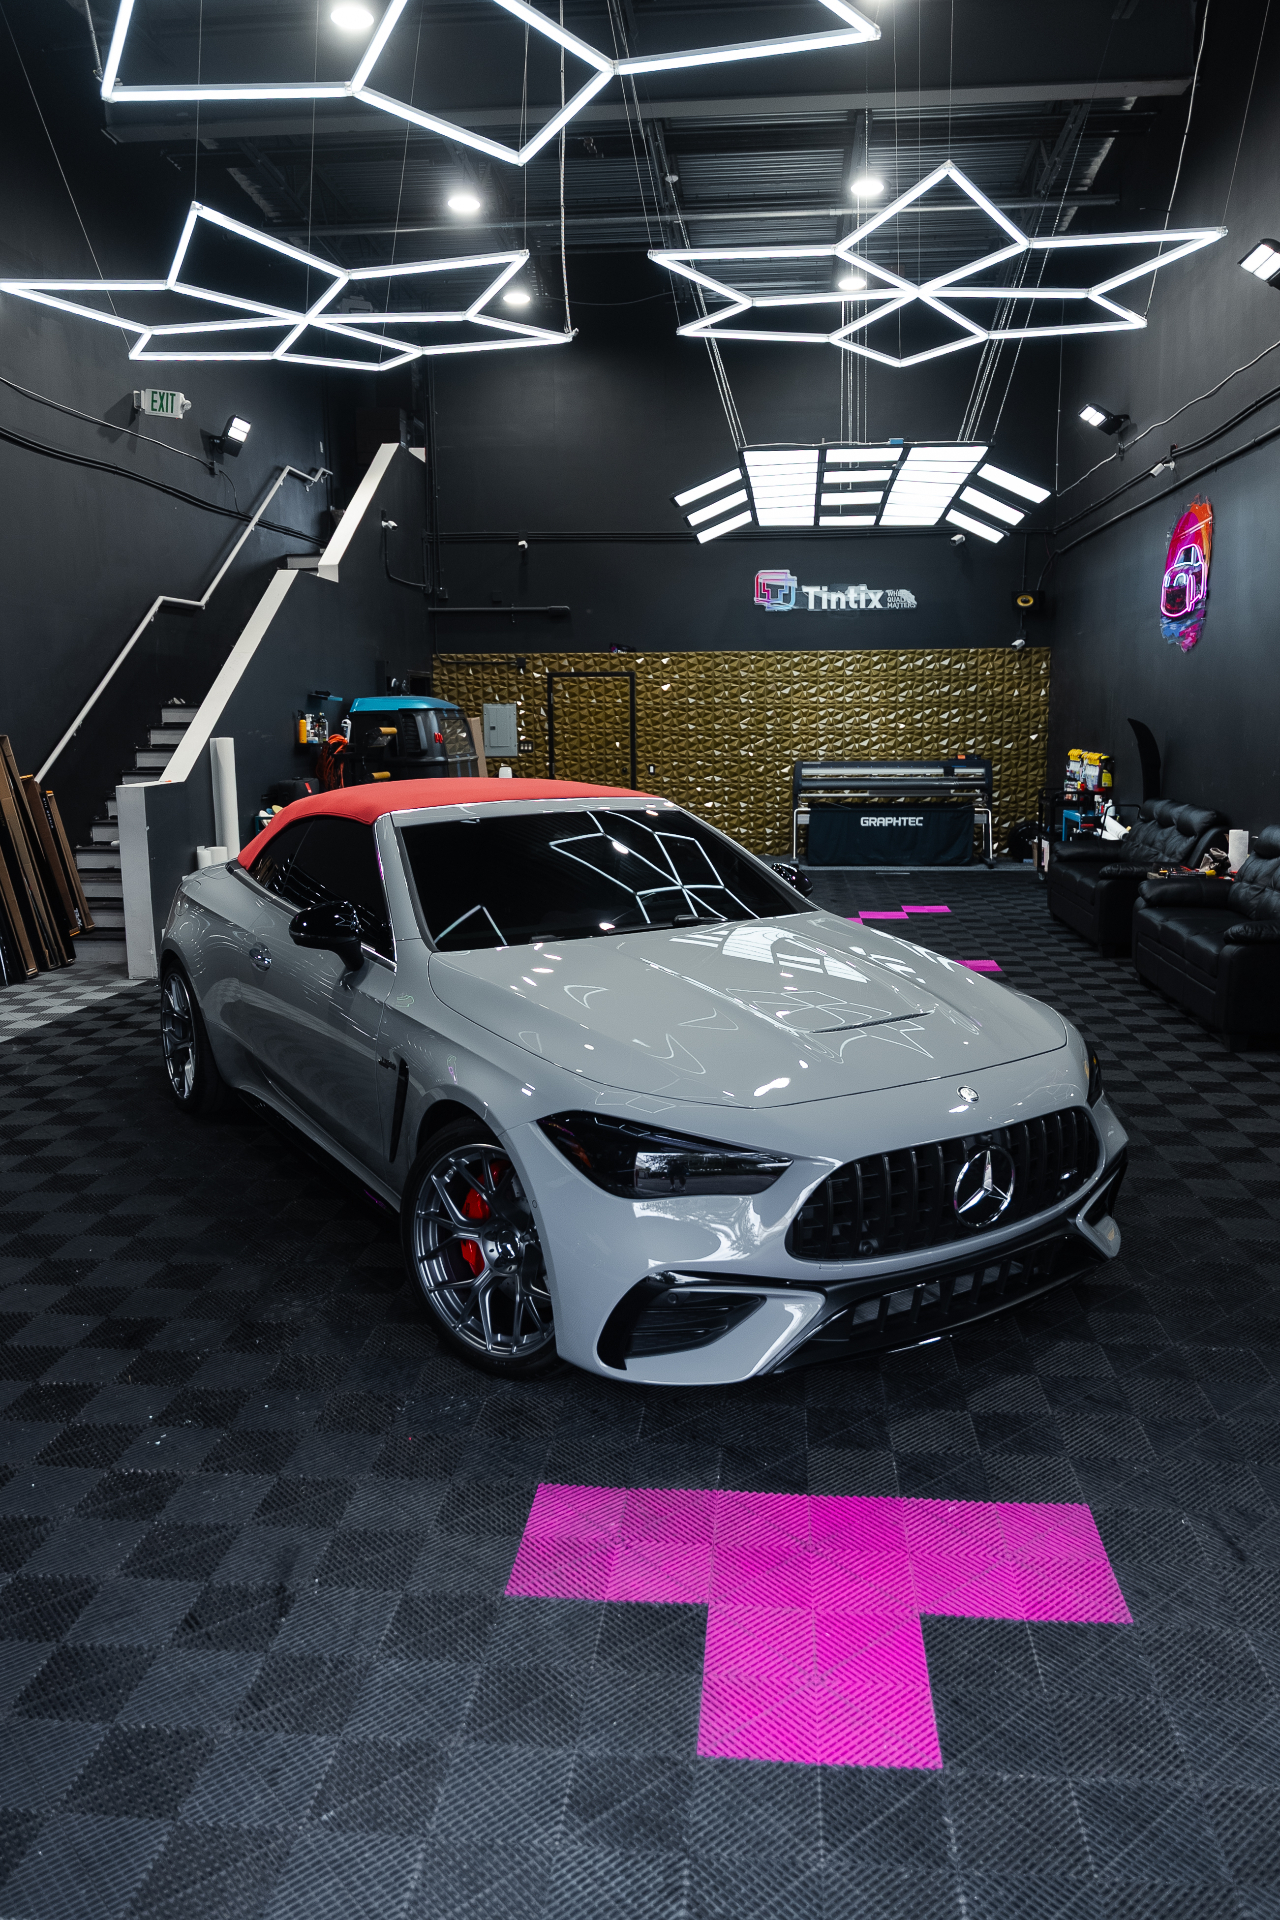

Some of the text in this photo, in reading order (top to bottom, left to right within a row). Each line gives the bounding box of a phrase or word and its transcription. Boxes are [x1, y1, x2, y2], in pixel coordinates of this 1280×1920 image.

[151, 391, 176, 413] EXIT
[802, 585, 884, 609] Tintix
[860, 816, 924, 827] GRAPHTEC
